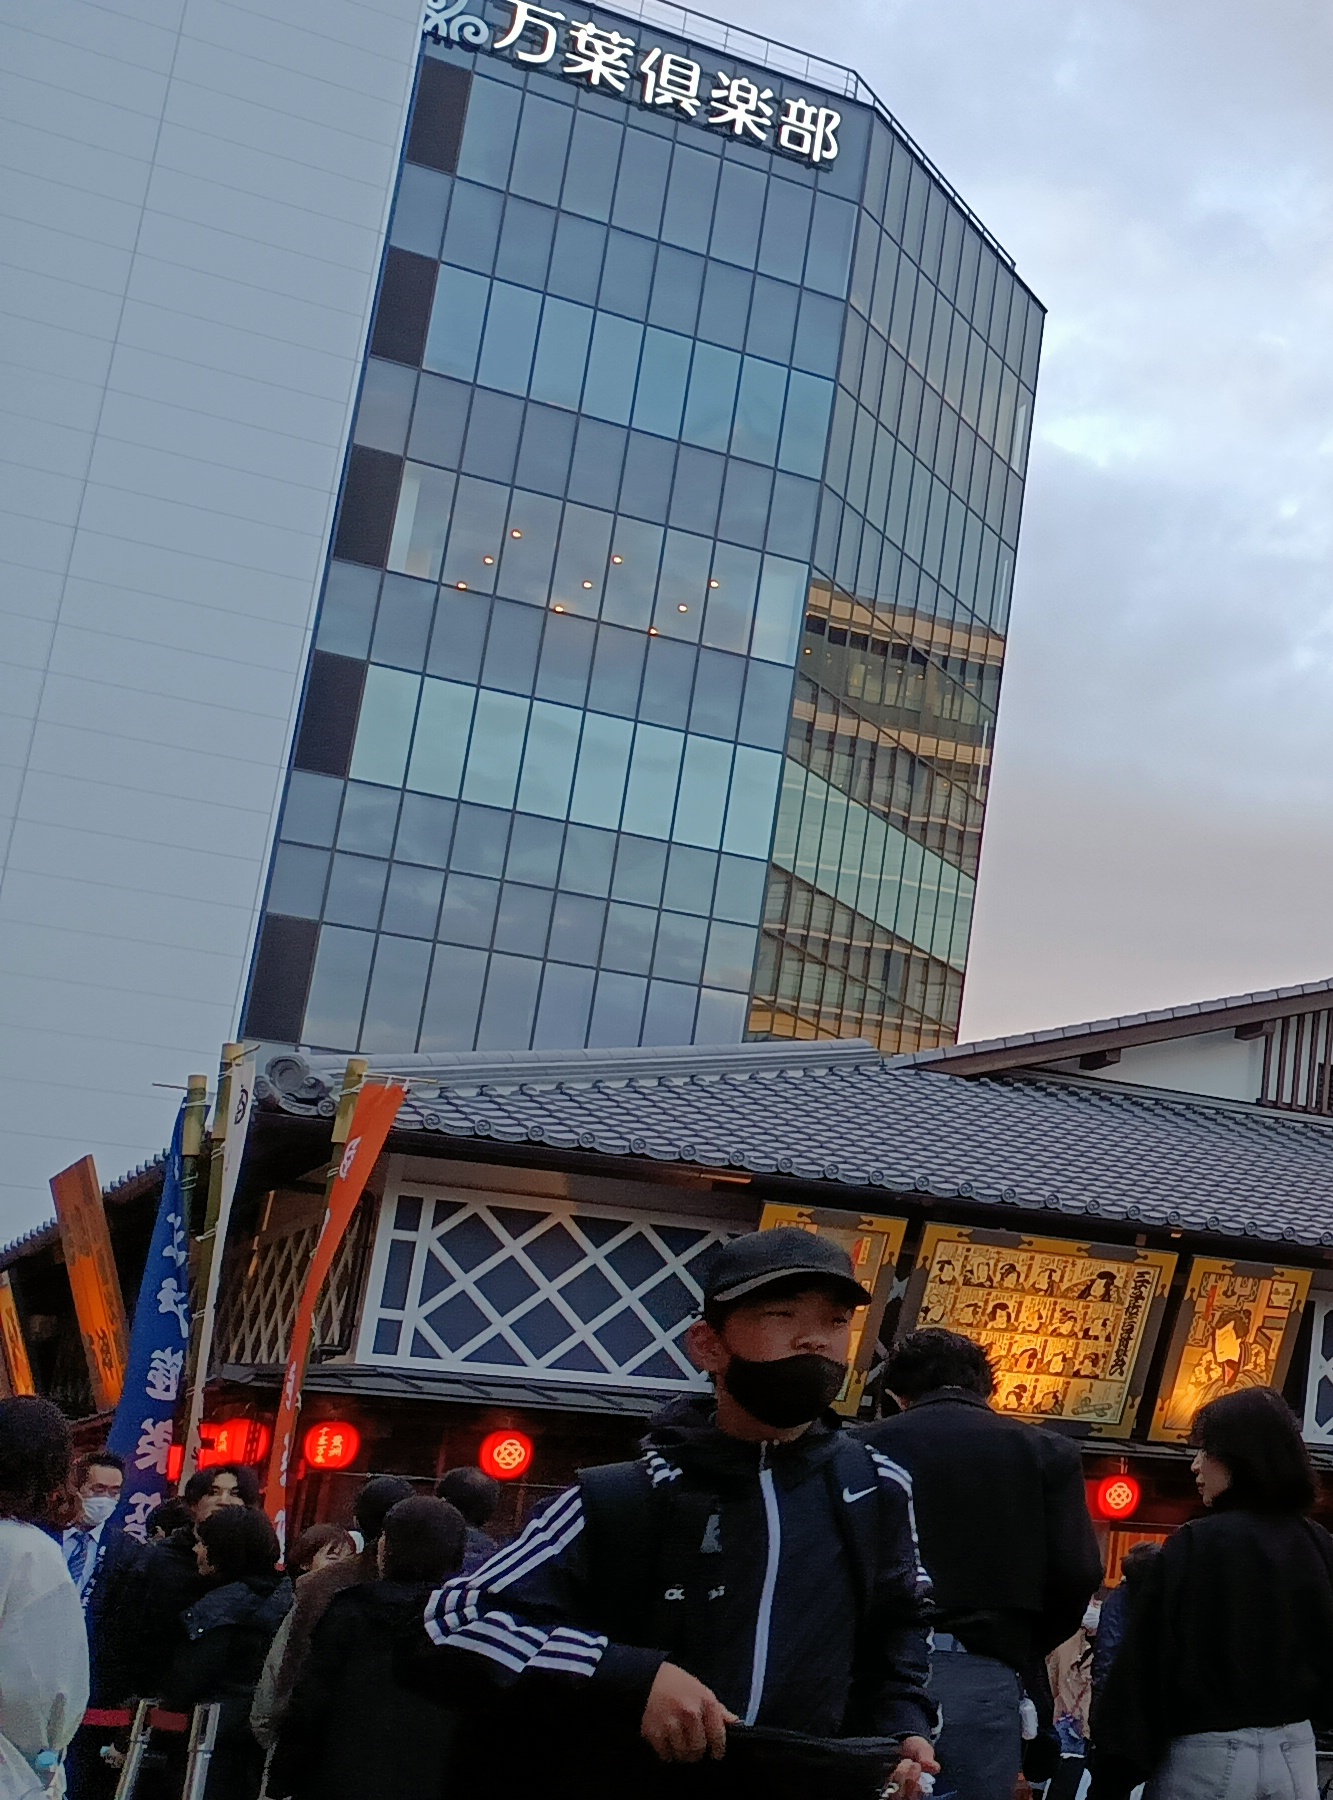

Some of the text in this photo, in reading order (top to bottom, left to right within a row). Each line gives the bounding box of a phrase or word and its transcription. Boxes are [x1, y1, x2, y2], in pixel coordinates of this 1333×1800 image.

[494, 0, 842, 163] 万葉倶楽部
